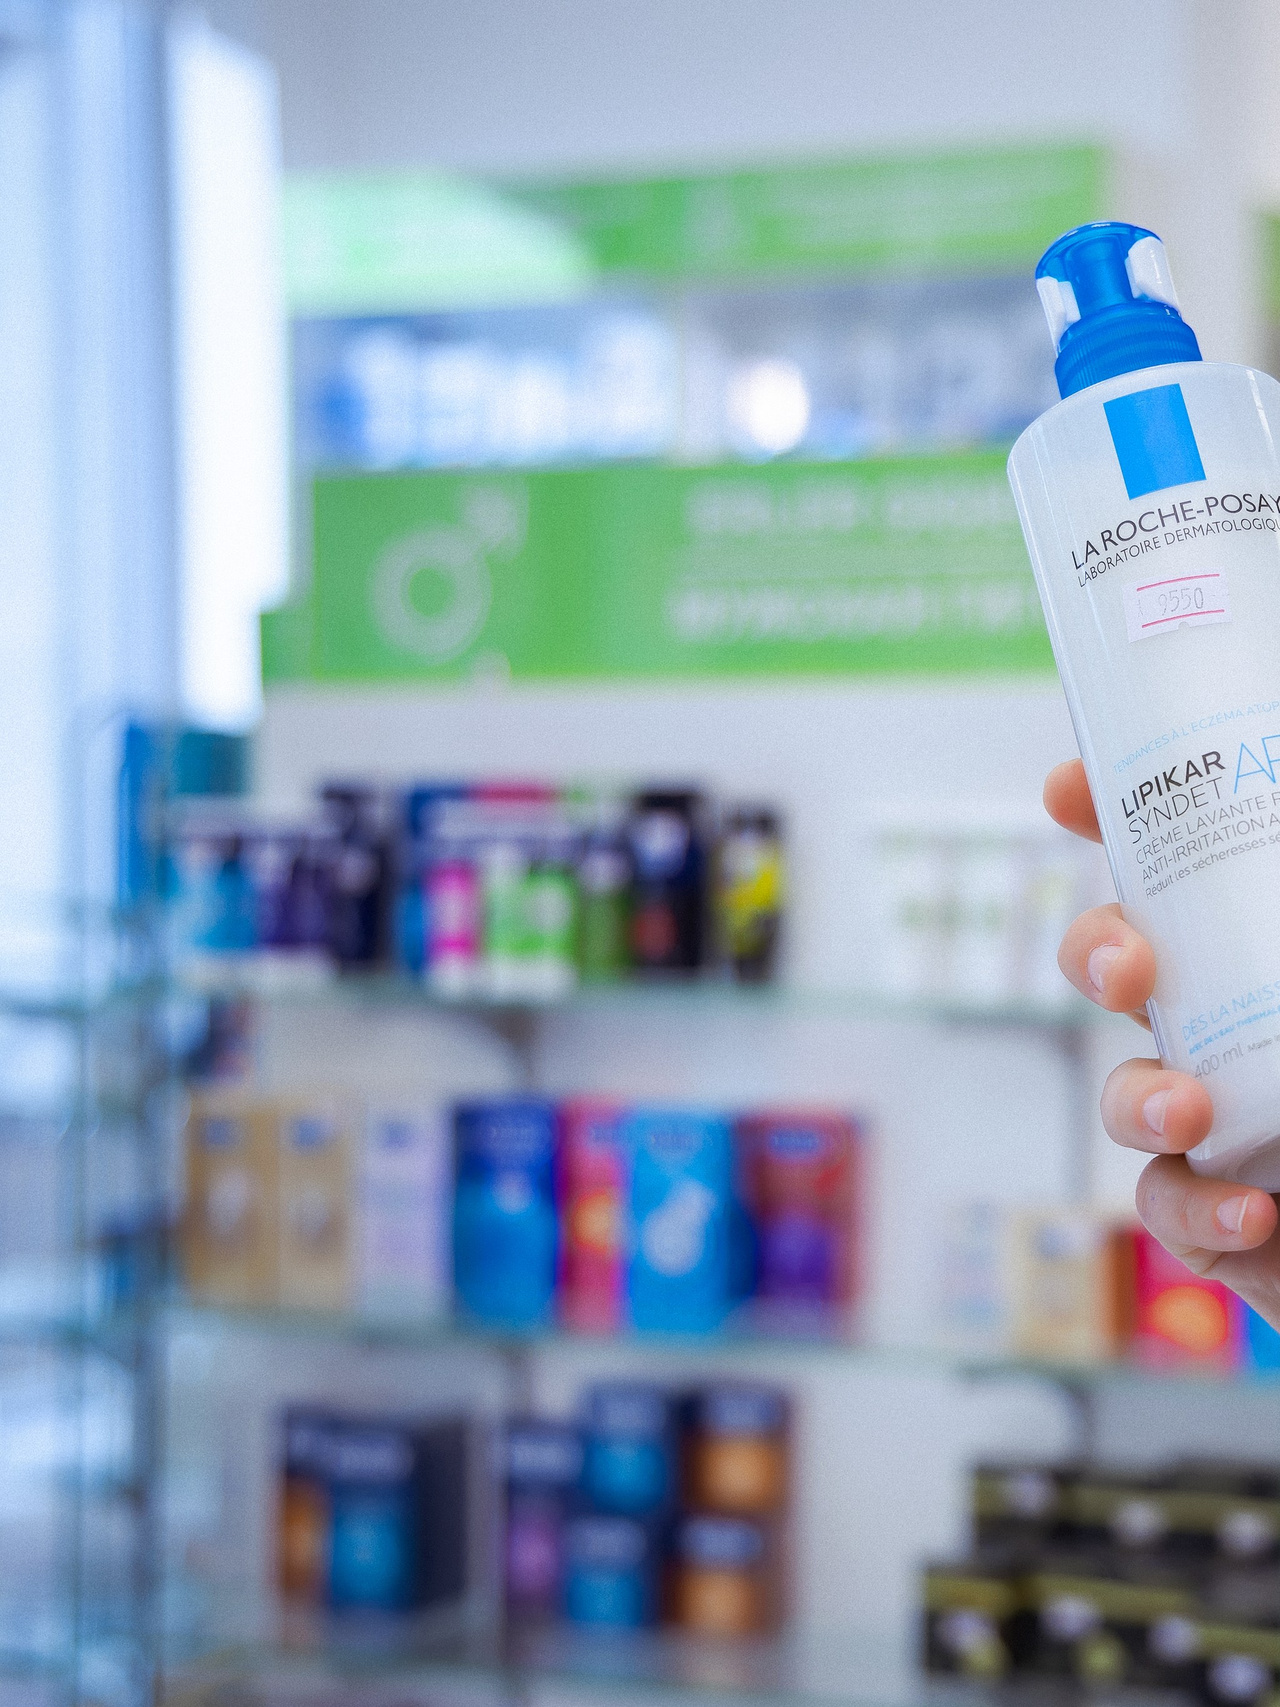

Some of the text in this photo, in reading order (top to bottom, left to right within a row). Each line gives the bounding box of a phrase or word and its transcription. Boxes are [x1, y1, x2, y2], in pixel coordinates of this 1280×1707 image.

[1071, 540, 1099, 570] LA
[1077, 536, 1161, 588] LABORATOIRE
[1158, 587, 1204, 616] 9550
[1113, 733, 1170, 774] TENDANCES
[1121, 751, 1226, 819] LIPIKAR
[1128, 776, 1222, 844] SYNDET
[1136, 825, 1183, 864] CRÈME
[1186, 795, 1267, 834] LAVANTE
[1142, 816, 1265, 884] ANTI-IRRITATION
[1145, 874, 1174, 899] Réduit
[1175, 865, 1191, 880] les
[1193, 837, 1267, 872] sécheresses
[1209, 1003, 1231, 1024] LA
[1194, 1053, 1220, 1079] 400
[1222, 1041, 1244, 1064] ml
